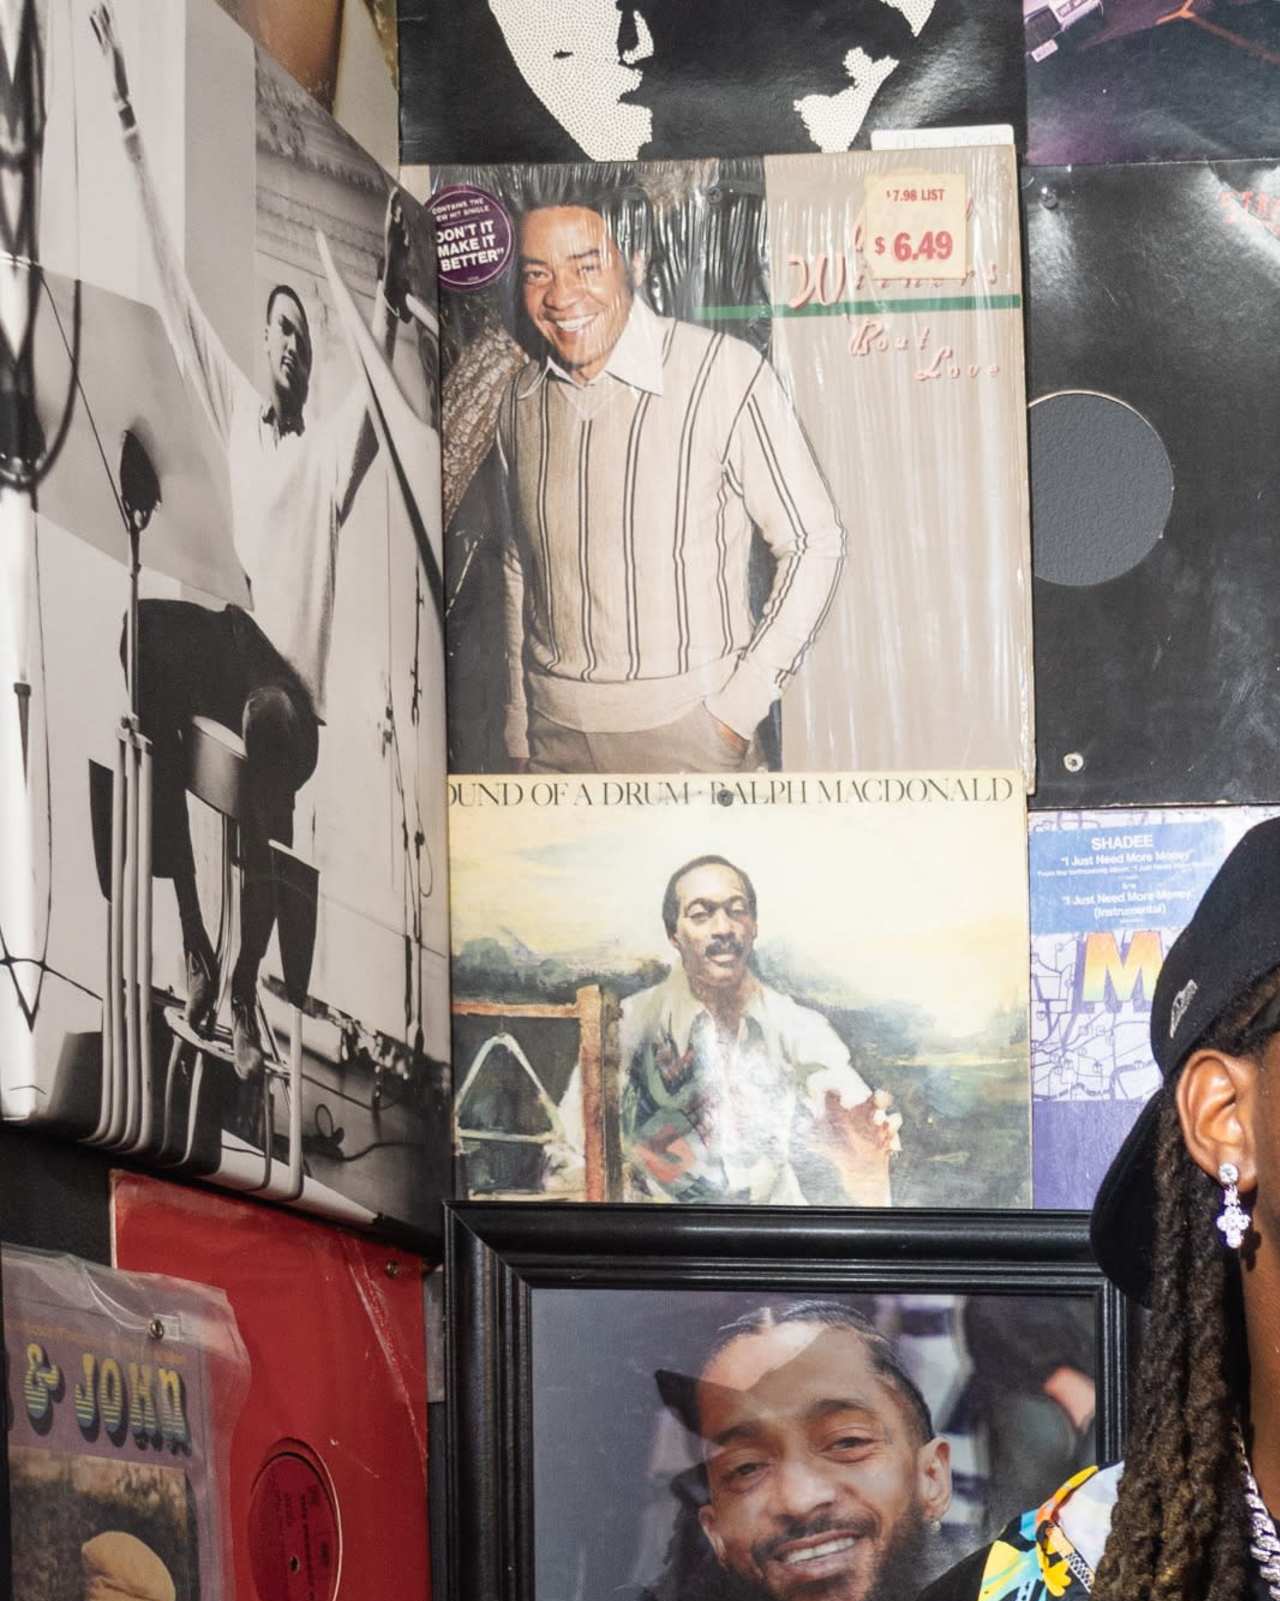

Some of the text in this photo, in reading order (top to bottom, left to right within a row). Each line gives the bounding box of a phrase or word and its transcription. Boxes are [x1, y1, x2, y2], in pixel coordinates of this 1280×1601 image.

[920, 187, 946, 202] LIST
[436, 214, 449, 223] EW
[479, 219, 495, 234] IT
[437, 233, 497, 259] MAKE IT
[448, 781, 525, 807] UND
[530, 781, 570, 807] OF
[573, 781, 594, 806] A
[602, 780, 690, 806] DRUM
[817, 776, 1014, 804] MACDONALD
[1090, 834, 1155, 851] SHADEE
